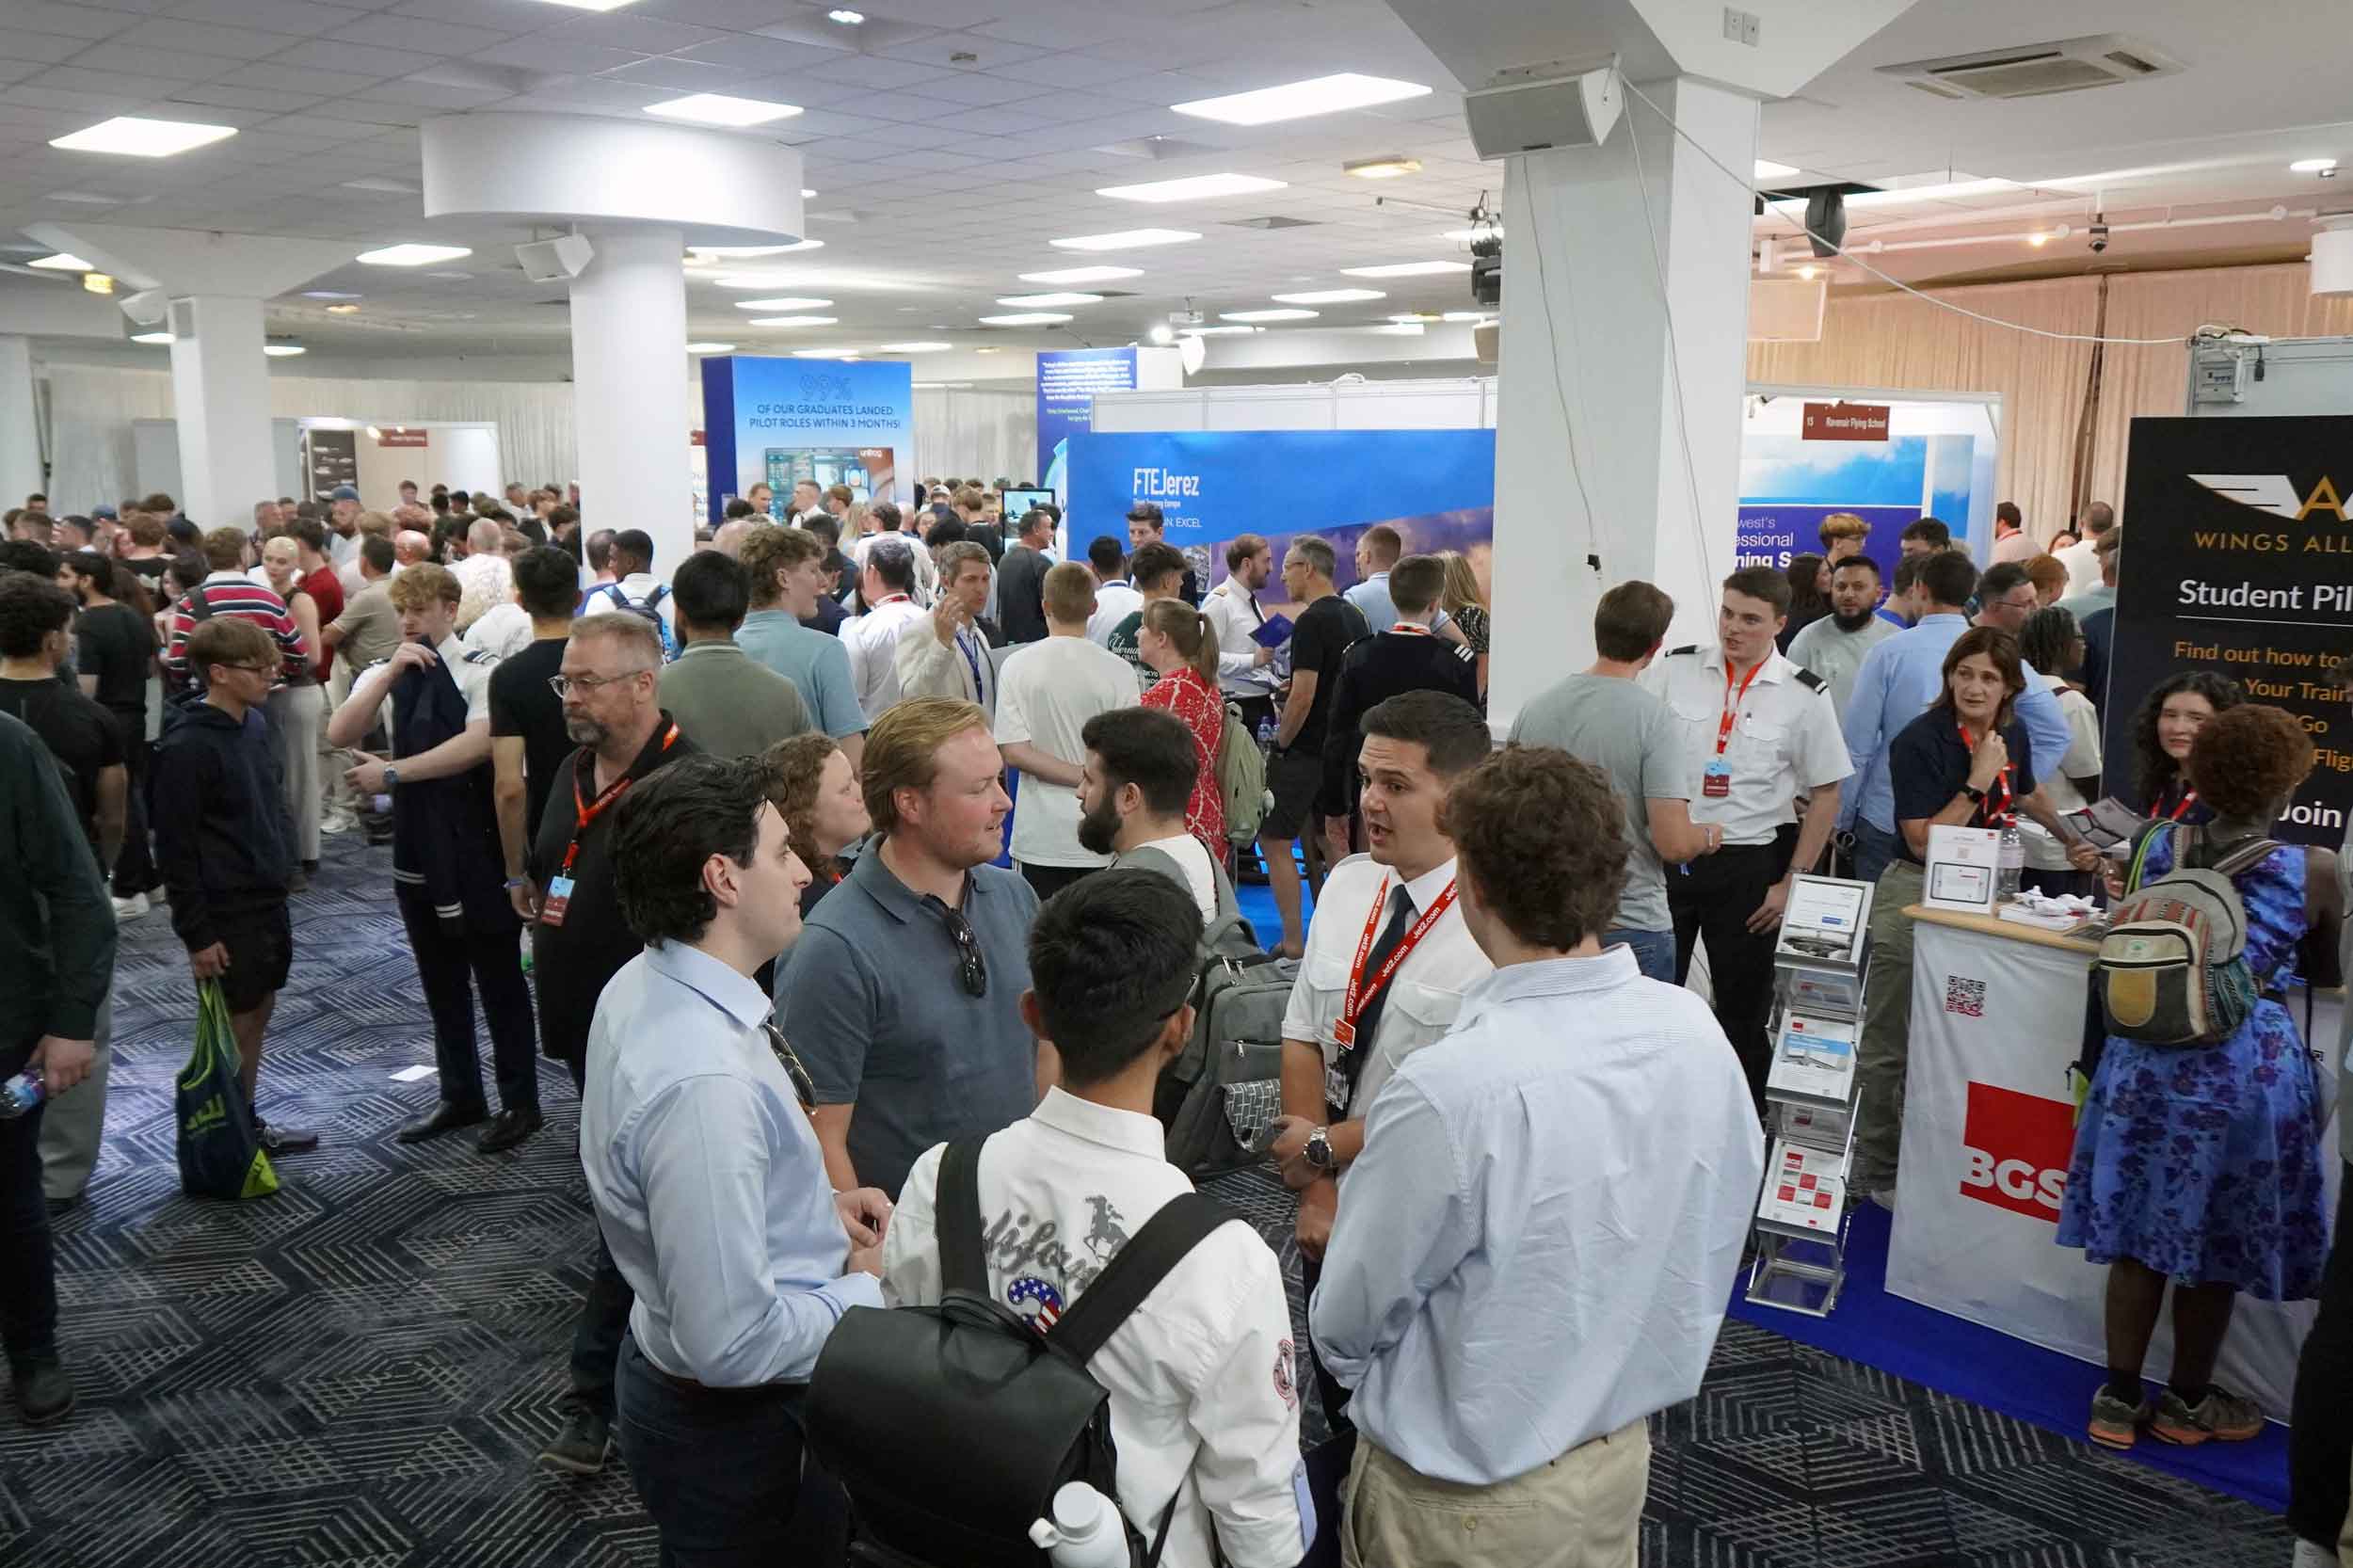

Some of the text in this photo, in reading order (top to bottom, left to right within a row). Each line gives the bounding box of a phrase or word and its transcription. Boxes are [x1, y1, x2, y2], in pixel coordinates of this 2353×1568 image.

[758, 405, 893, 416] OF OUR GRADUATES LANDED
[749, 418, 778, 428] PILOT
[780, 418, 811, 428] ROLES
[813, 418, 848, 428] WITHIN
[1132, 468, 1200, 497] FTEJerez
[1176, 518, 1203, 528] EXCEL
[1735, 531, 1794, 547] essional
[2194, 531, 2353, 553] WINGS ALL
[1733, 552, 1774, 568] ning
[2178, 579, 2353, 612] Student Pil
[2174, 641, 2218, 661] Find
[2224, 648, 2260, 664] out
[2266, 647, 2313, 666] how
[2245, 678, 2295, 698] Your
[2278, 801, 2343, 828] Join
[1414, 906, 1441, 939] Jet2.com
[1383, 944, 1409, 977] Jet2.com
